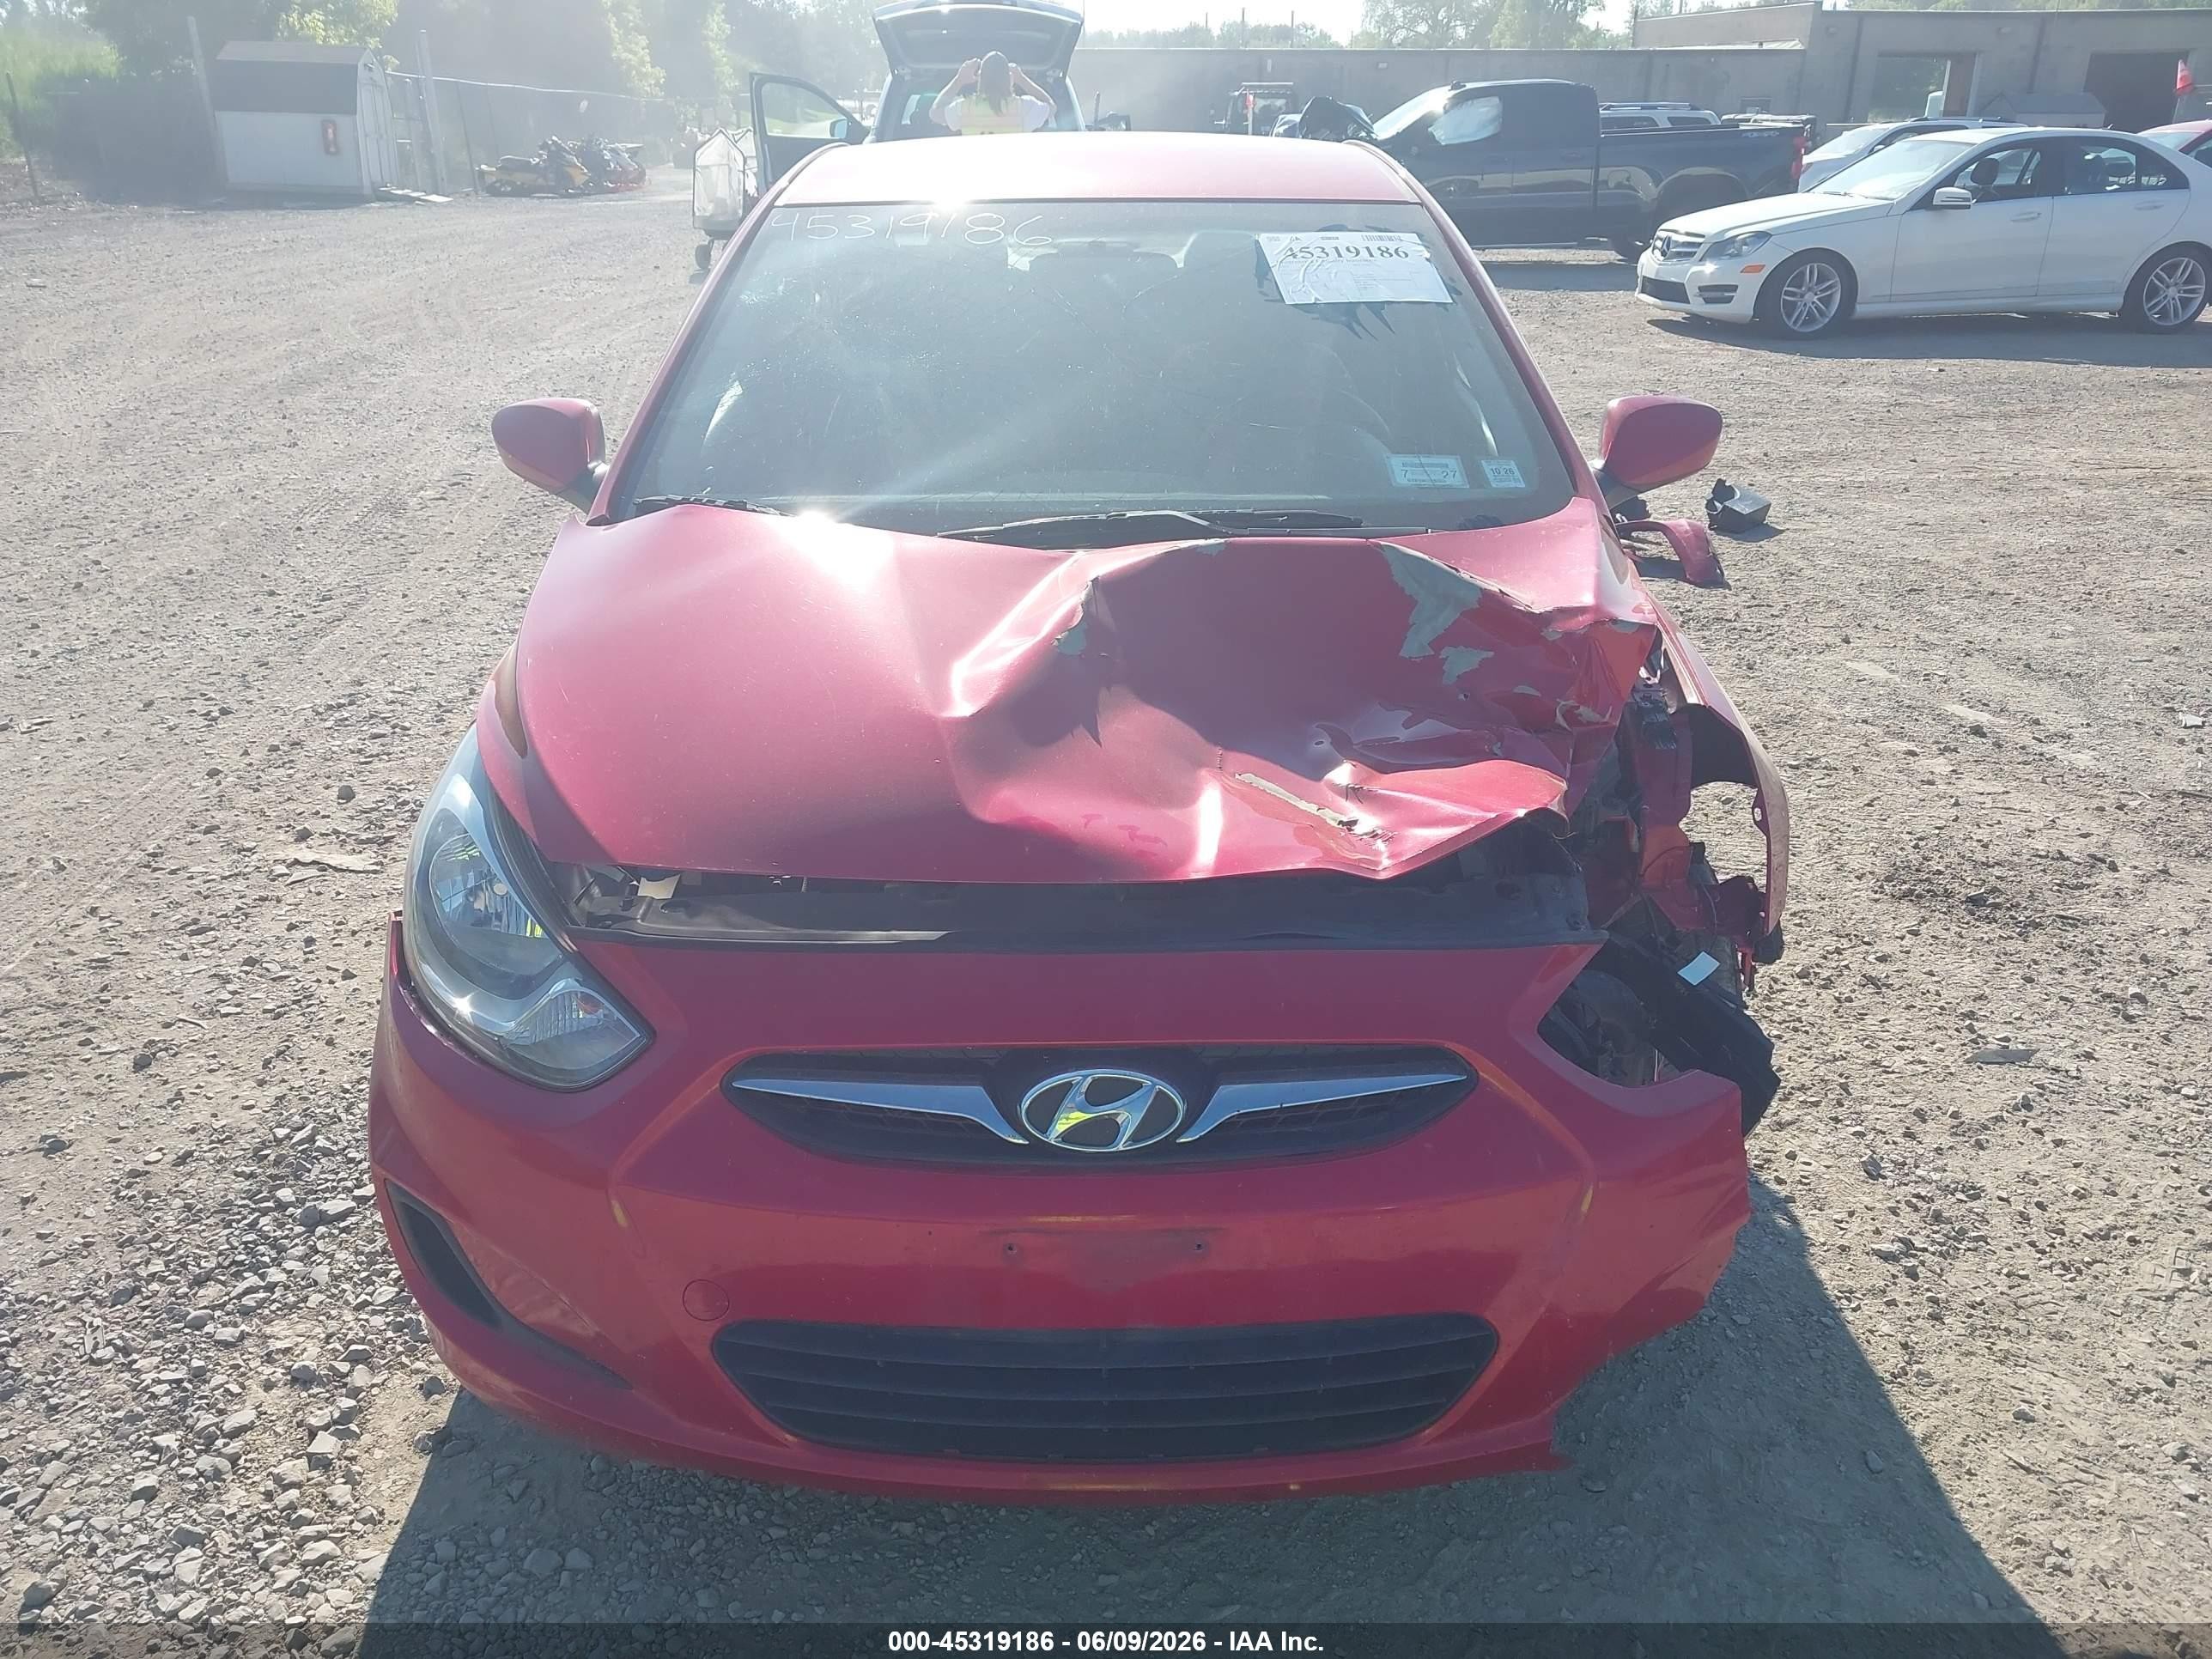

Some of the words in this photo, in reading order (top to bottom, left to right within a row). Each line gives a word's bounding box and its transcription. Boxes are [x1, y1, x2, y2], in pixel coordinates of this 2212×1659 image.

[771, 213, 1052, 246] 45319186
[1285, 246, 1409, 258] 45319186
[1401, 469, 1409, 478] 7
[1442, 470, 1457, 479] 27
